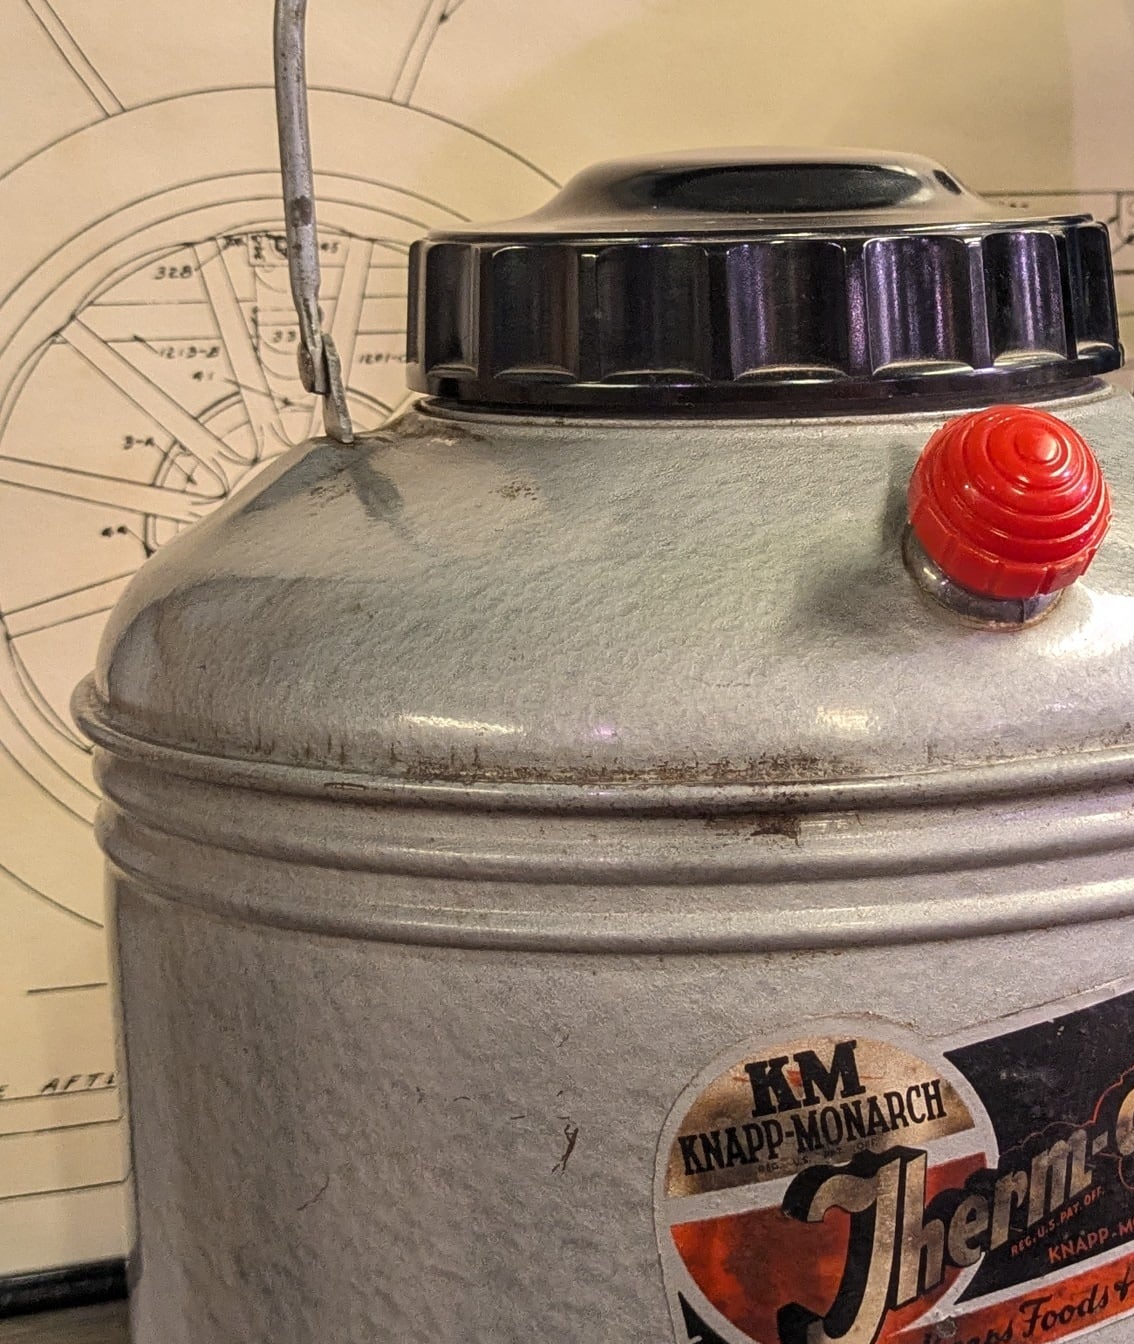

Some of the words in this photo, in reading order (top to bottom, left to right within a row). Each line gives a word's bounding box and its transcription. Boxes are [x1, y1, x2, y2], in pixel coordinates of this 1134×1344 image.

[744, 1040, 866, 1117] KM
[678, 1079, 948, 1176] KNAPP-MONARCH
[1018, 1284, 1109, 1338] Foods
